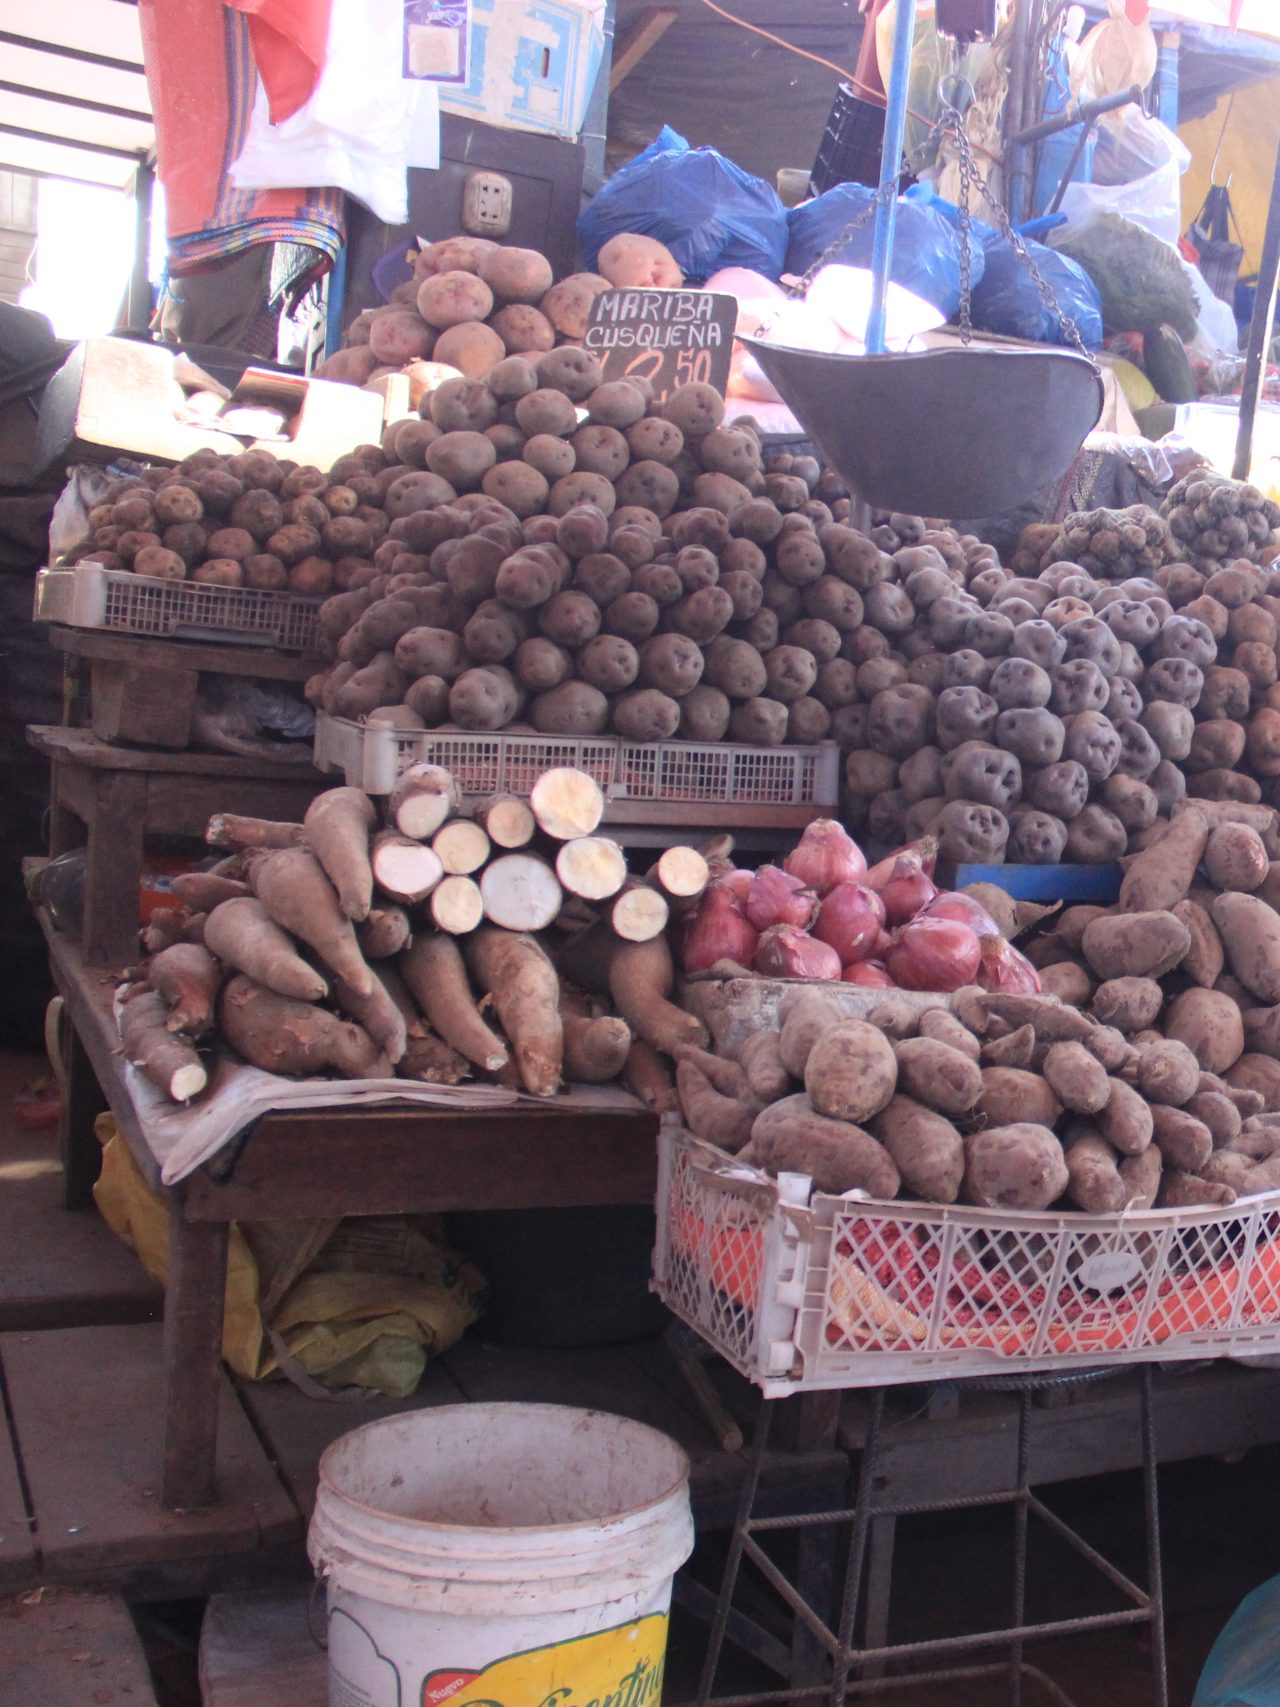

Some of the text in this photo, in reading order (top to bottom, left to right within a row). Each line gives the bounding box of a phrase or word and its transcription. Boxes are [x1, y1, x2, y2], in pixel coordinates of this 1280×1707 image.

[596, 292, 714, 323] MARIBA
[585, 320, 722, 348] CUSQUEÑA
[428, 1677, 465, 1704] Nuevo
